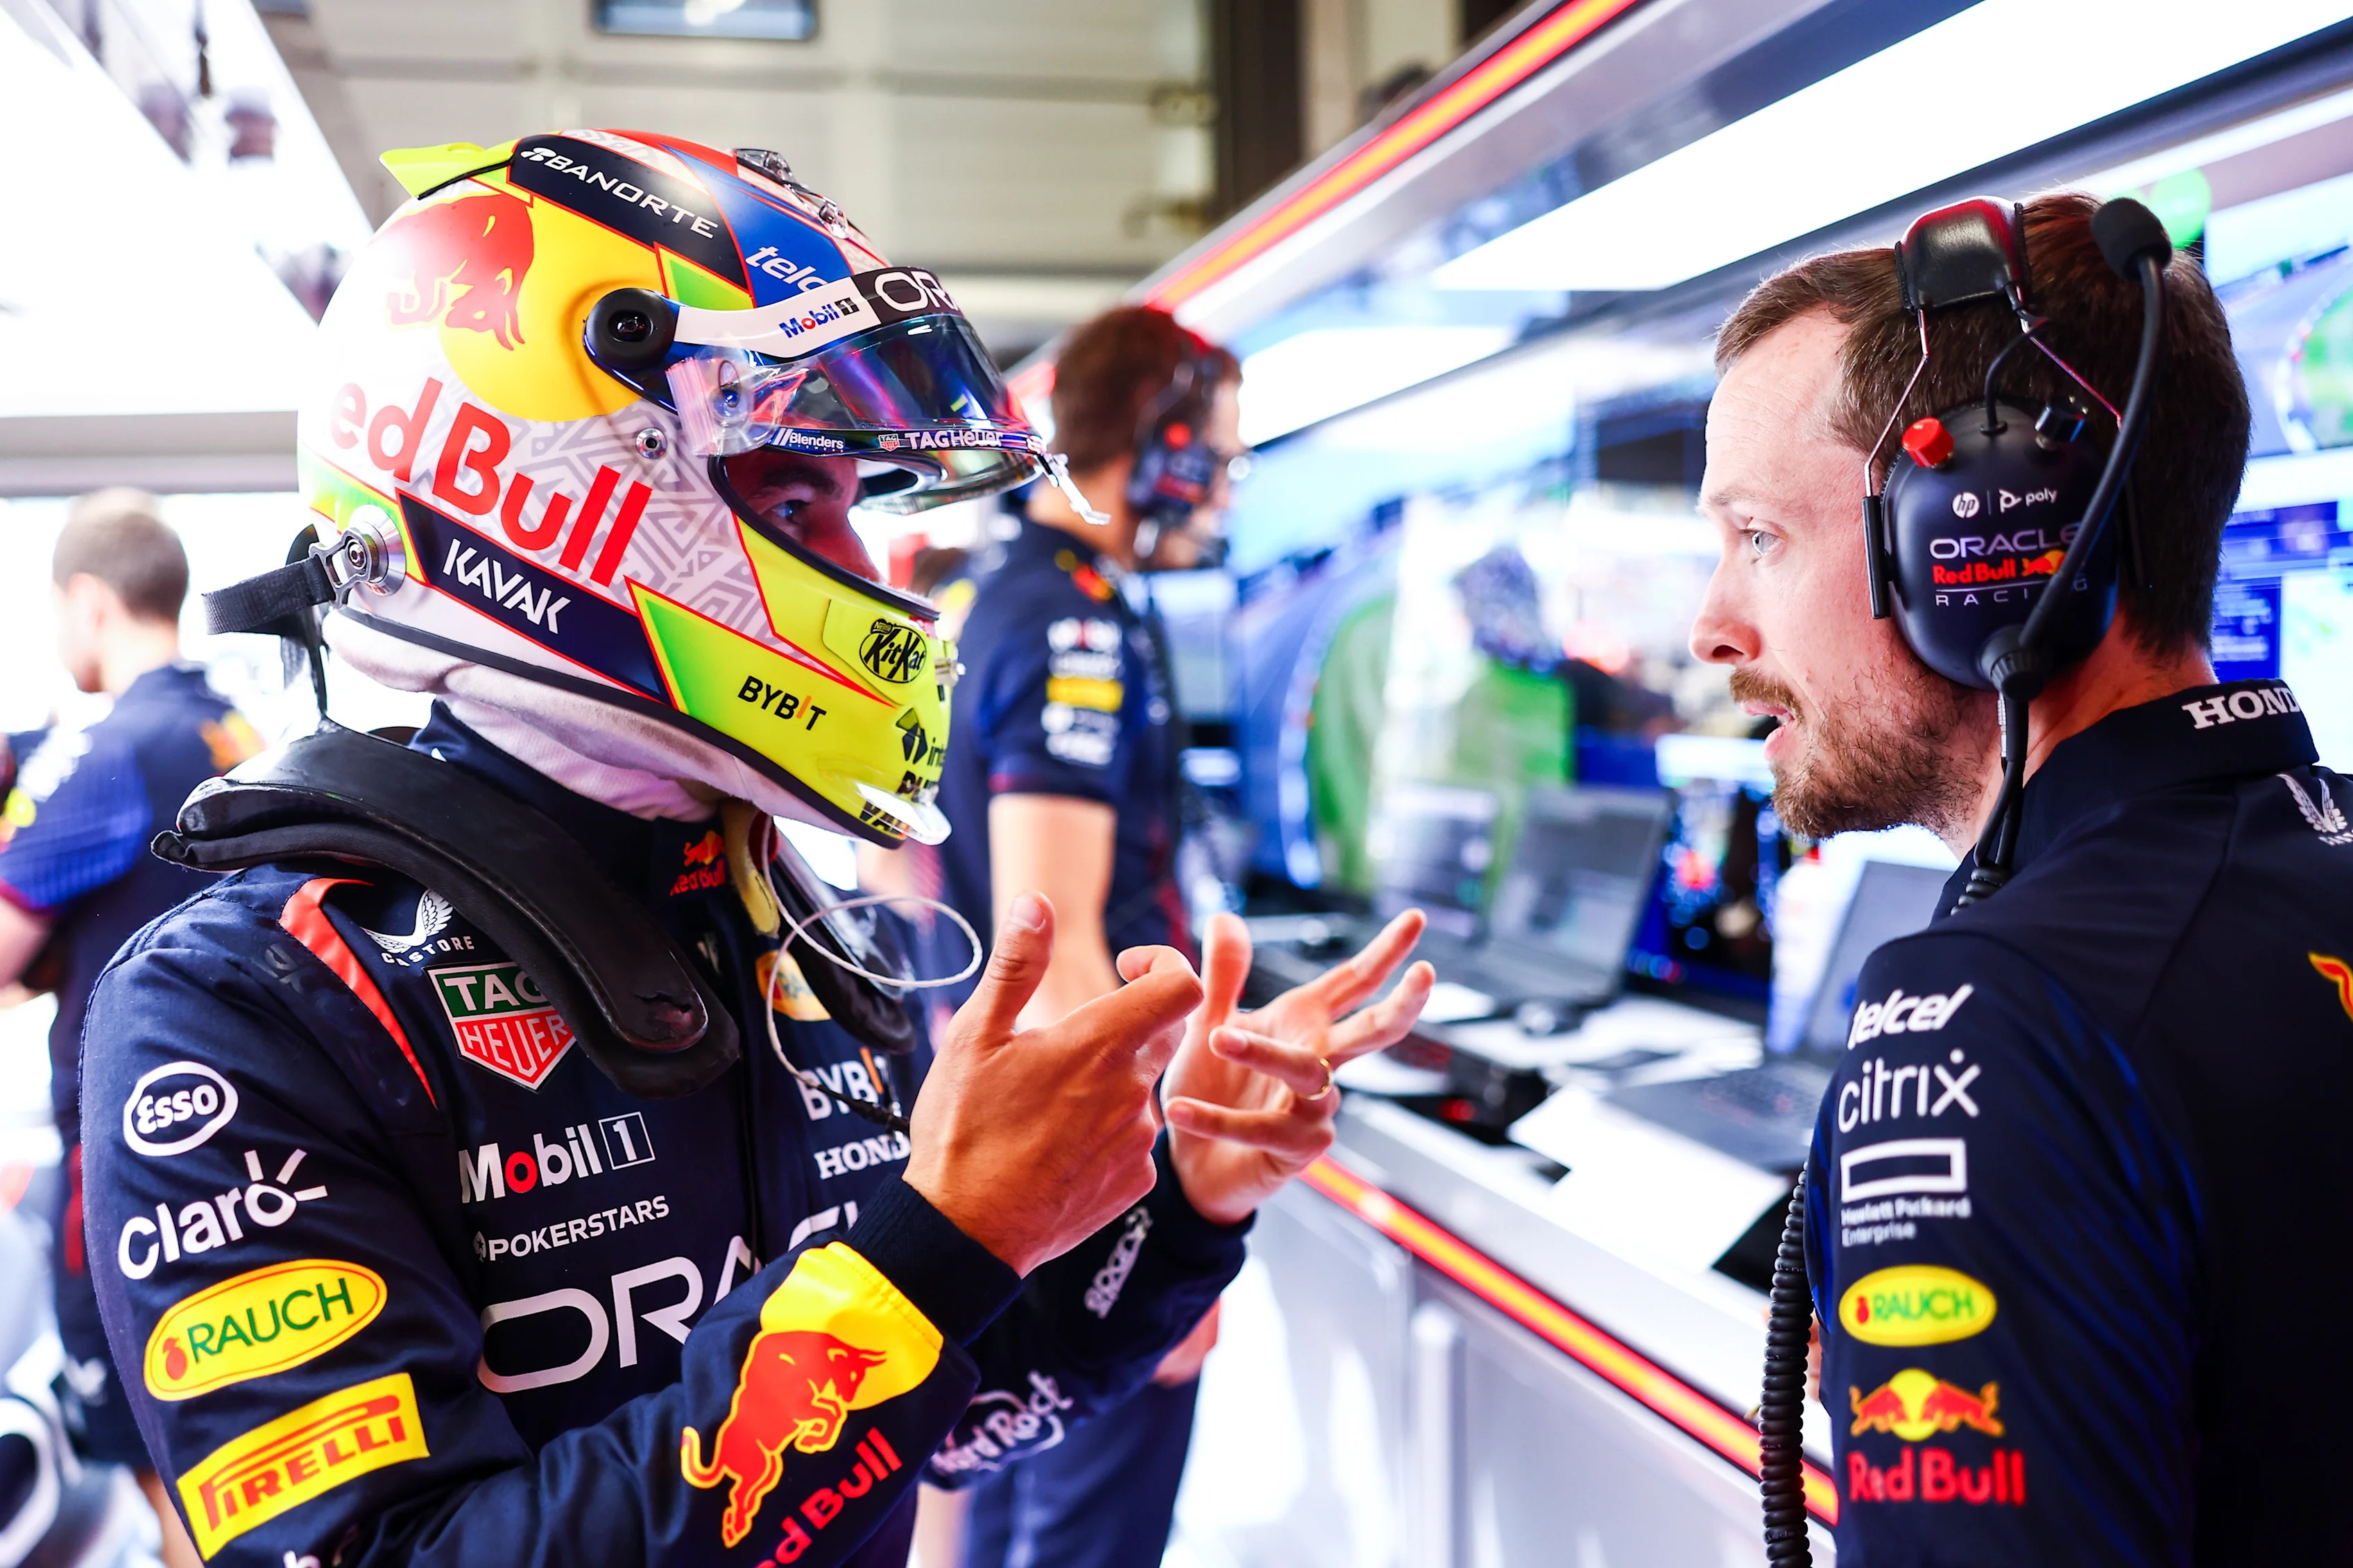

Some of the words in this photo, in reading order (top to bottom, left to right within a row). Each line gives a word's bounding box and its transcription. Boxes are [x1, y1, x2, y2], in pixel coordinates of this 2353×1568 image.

[547, 154, 719, 240] BANORTE
[779, 304, 840, 338] Mobil
[789, 432, 844, 450] Blenders
[431, 402, 653, 588] Bull
[2025, 488, 2057, 507] poly
[442, 537, 571, 635] KAVAK
[1932, 563, 1973, 585] Red
[1974, 558, 2016, 582] Bull
[1935, 578, 2087, 607] RACIG
[737, 674, 828, 731] BYBIT
[381, 935, 475, 967] CASTORE
[443, 970, 549, 1012] TAG
[1847, 983, 1974, 1050] telcel
[461, 1015, 569, 1078] HEUER
[1838, 1049, 1980, 1132] citrix
[459, 1123, 604, 1205] Mobil
[118, 1177, 298, 1280] Claro
[488, 1195, 670, 1261] POKERSTARS
[187, 1277, 354, 1364] RAUCH
[1873, 1290, 1975, 1321] RAUCH
[198, 1394, 407, 1531] PIRELLI
[799, 1426, 902, 1531] Bull
[1846, 1447, 1915, 1502] Red
[1919, 1447, 2027, 1506] Bull
